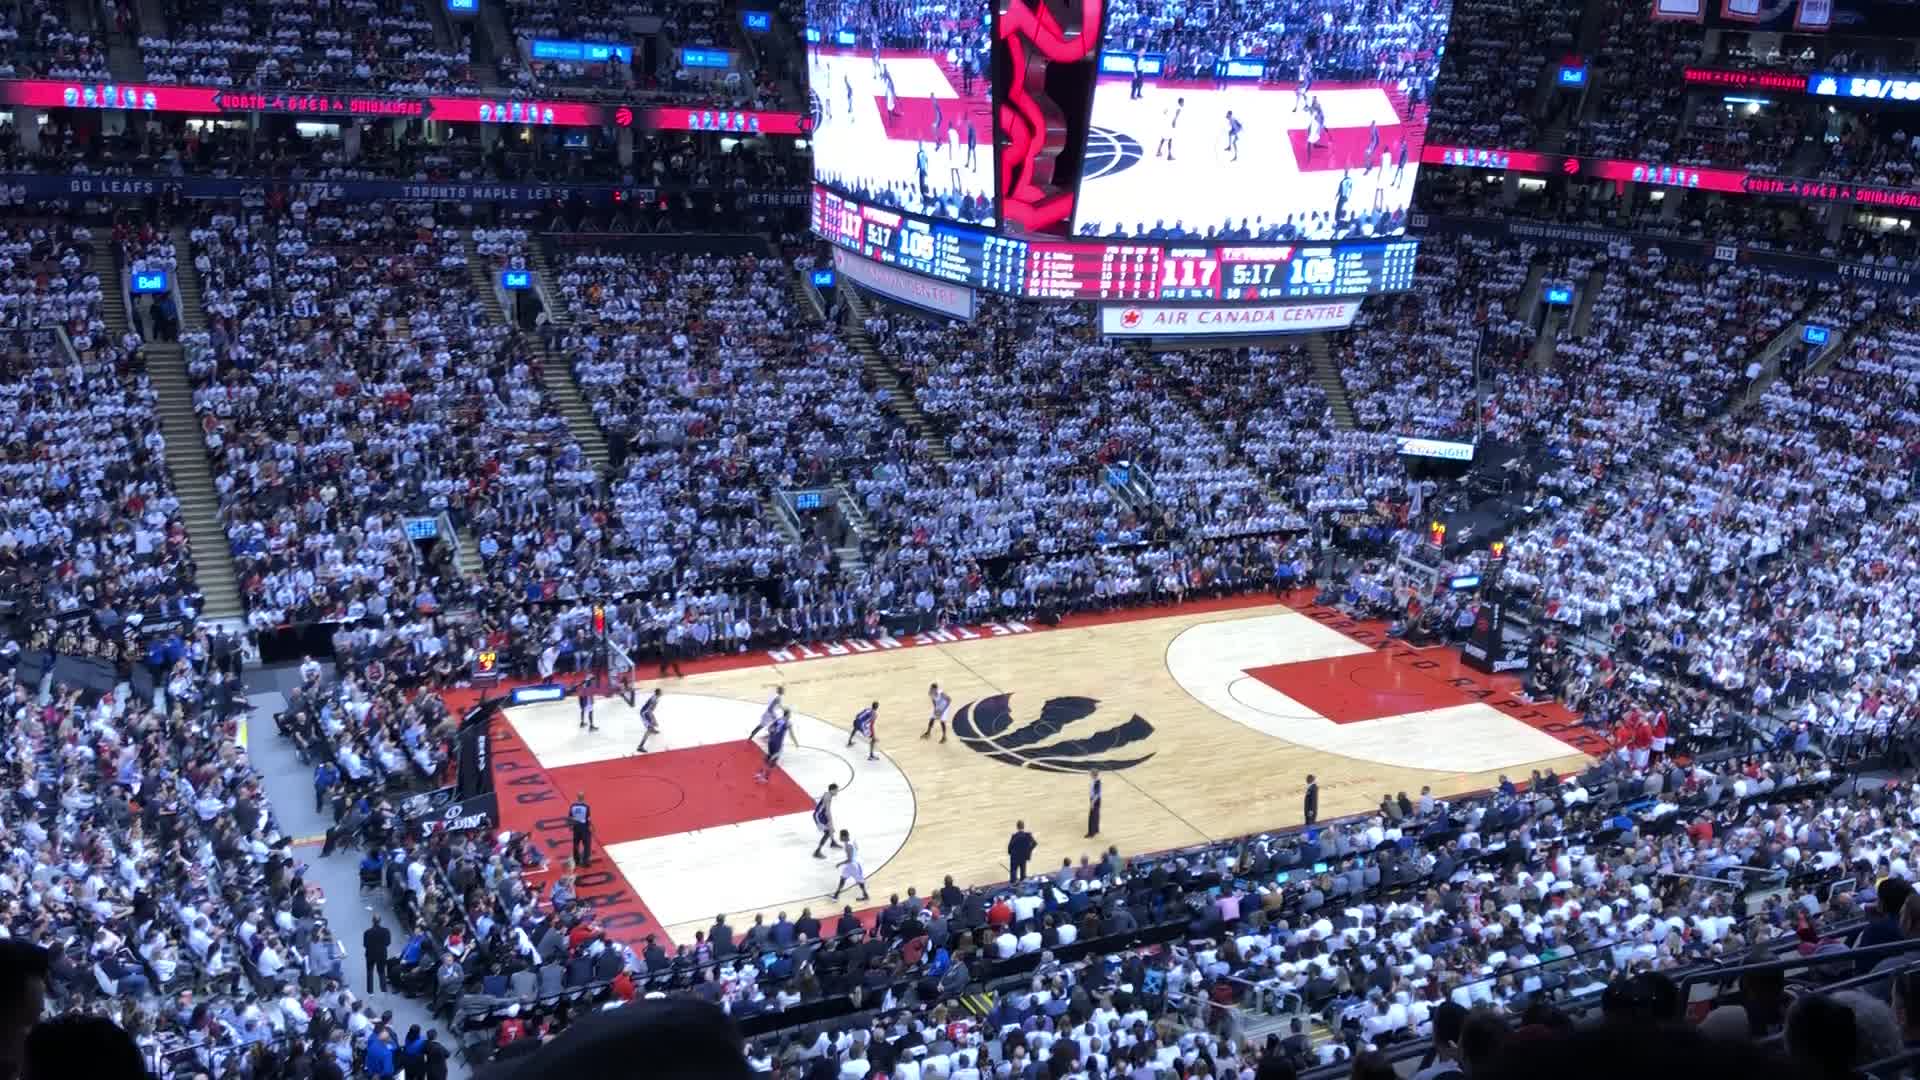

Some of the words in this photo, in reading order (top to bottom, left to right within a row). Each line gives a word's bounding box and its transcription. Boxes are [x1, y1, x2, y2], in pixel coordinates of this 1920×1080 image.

[71, 180, 91, 192] GO
[101, 181, 153, 193] LEAFS
[403, 186, 466, 198] TORONTO
[473, 188, 517, 199] MAPLE
[527, 189, 569, 200] LEAS
[900, 228, 935, 261] 105
[507, 274, 526, 286] Bell
[1162, 260, 1217, 286] 117
[1233, 263, 1277, 285] 5:17
[1852, 266, 1872, 278] THE
[1874, 271, 1910, 284] NORTH
[138, 277, 161, 290] Bell
[1153, 311, 1187, 325] AIR
[1198, 308, 1275, 325] CANADA
[1283, 305, 1345, 322] CENTRE
